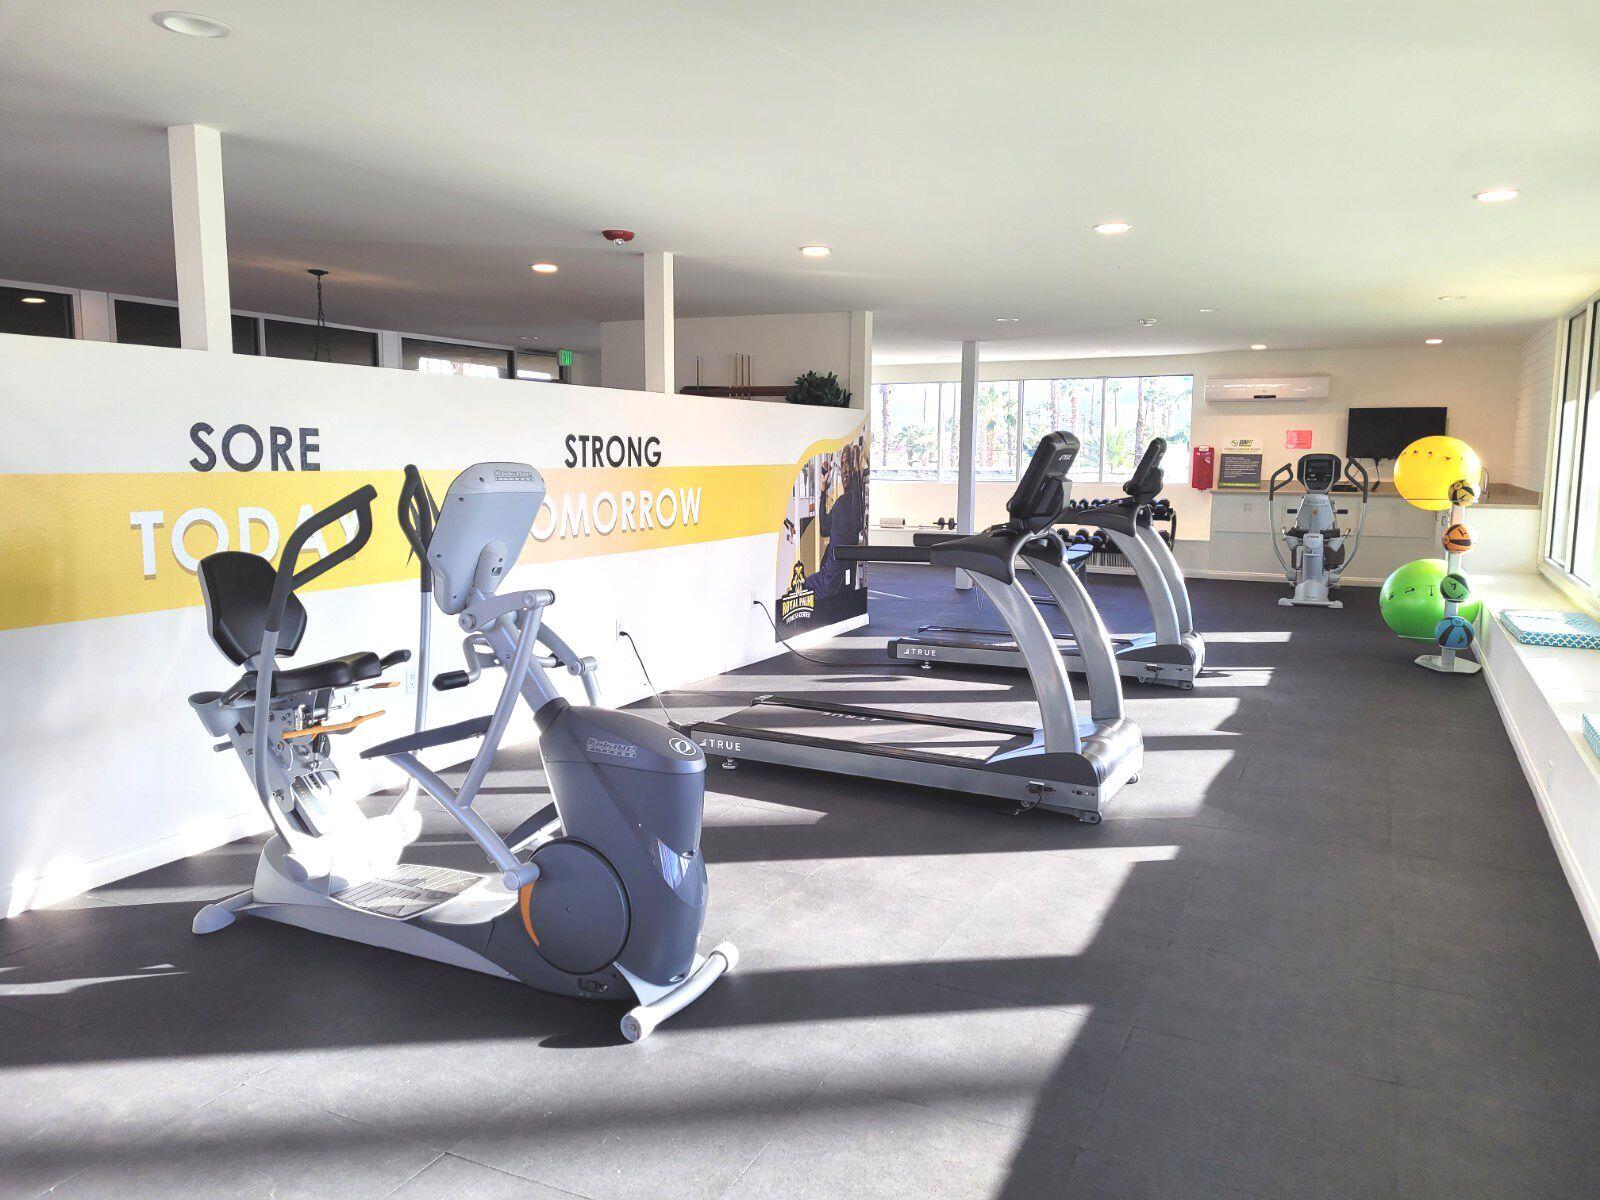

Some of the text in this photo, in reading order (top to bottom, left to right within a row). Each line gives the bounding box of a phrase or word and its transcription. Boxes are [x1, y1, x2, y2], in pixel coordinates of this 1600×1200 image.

[189, 422, 321, 472] SORE
[564, 433, 662, 469] STRONG
[530, 486, 703, 542] OMORROW
[911, 648, 937, 657] TRUE
[709, 739, 742, 752] TRUE
